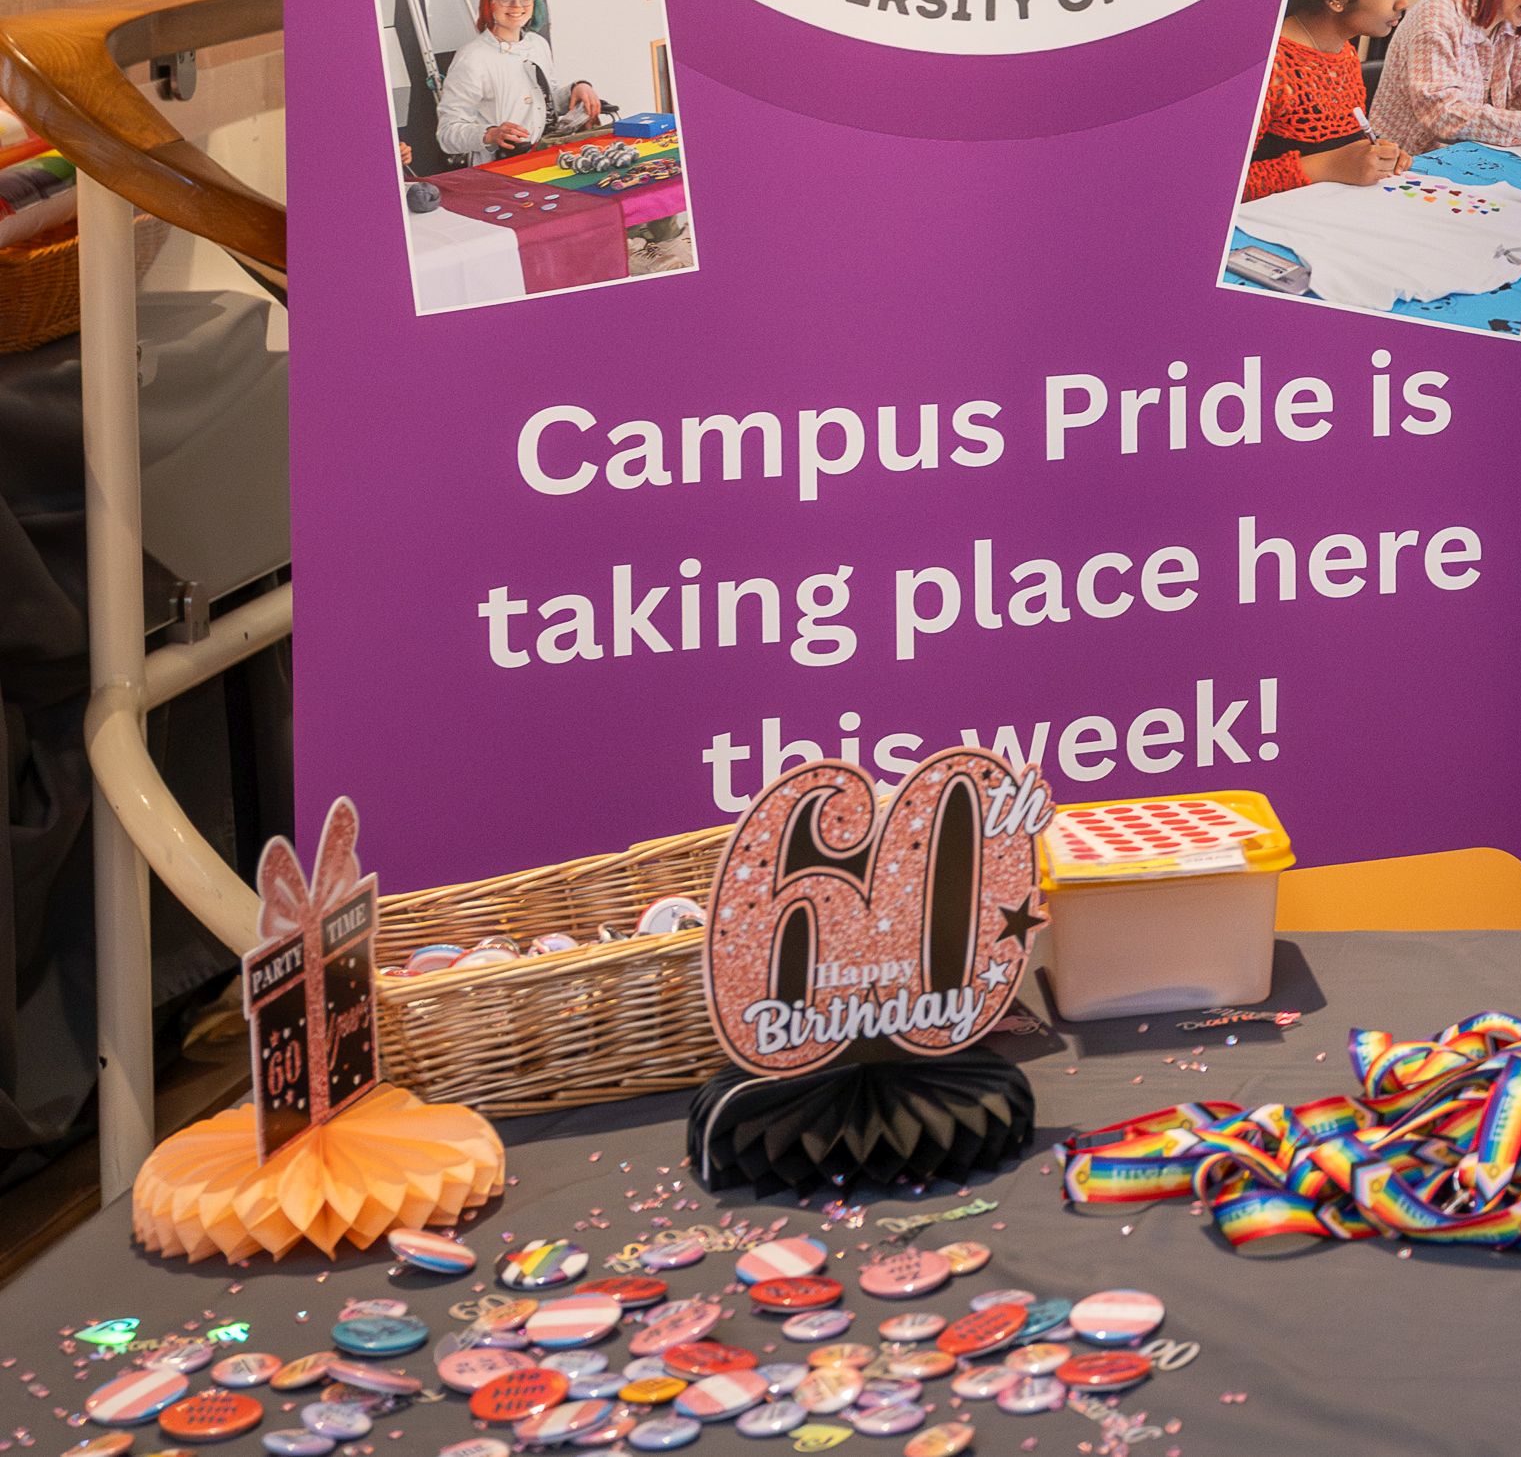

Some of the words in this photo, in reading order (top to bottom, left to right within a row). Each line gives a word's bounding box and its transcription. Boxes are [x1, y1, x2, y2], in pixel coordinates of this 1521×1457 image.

[517, 399, 1005, 502] Campus
[1045, 355, 1334, 461] Pride
[1371, 349, 1452, 437] is
[478, 558, 858, 667] taking
[895, 538, 1200, 661] place
[1238, 515, 1482, 604] here
[326, 902, 367, 945] TIME
[251, 942, 304, 995] PARTY
[813, 958, 919, 992] Happy
[742, 984, 988, 1056] Birthday
[267, 1040, 303, 1097] 60
